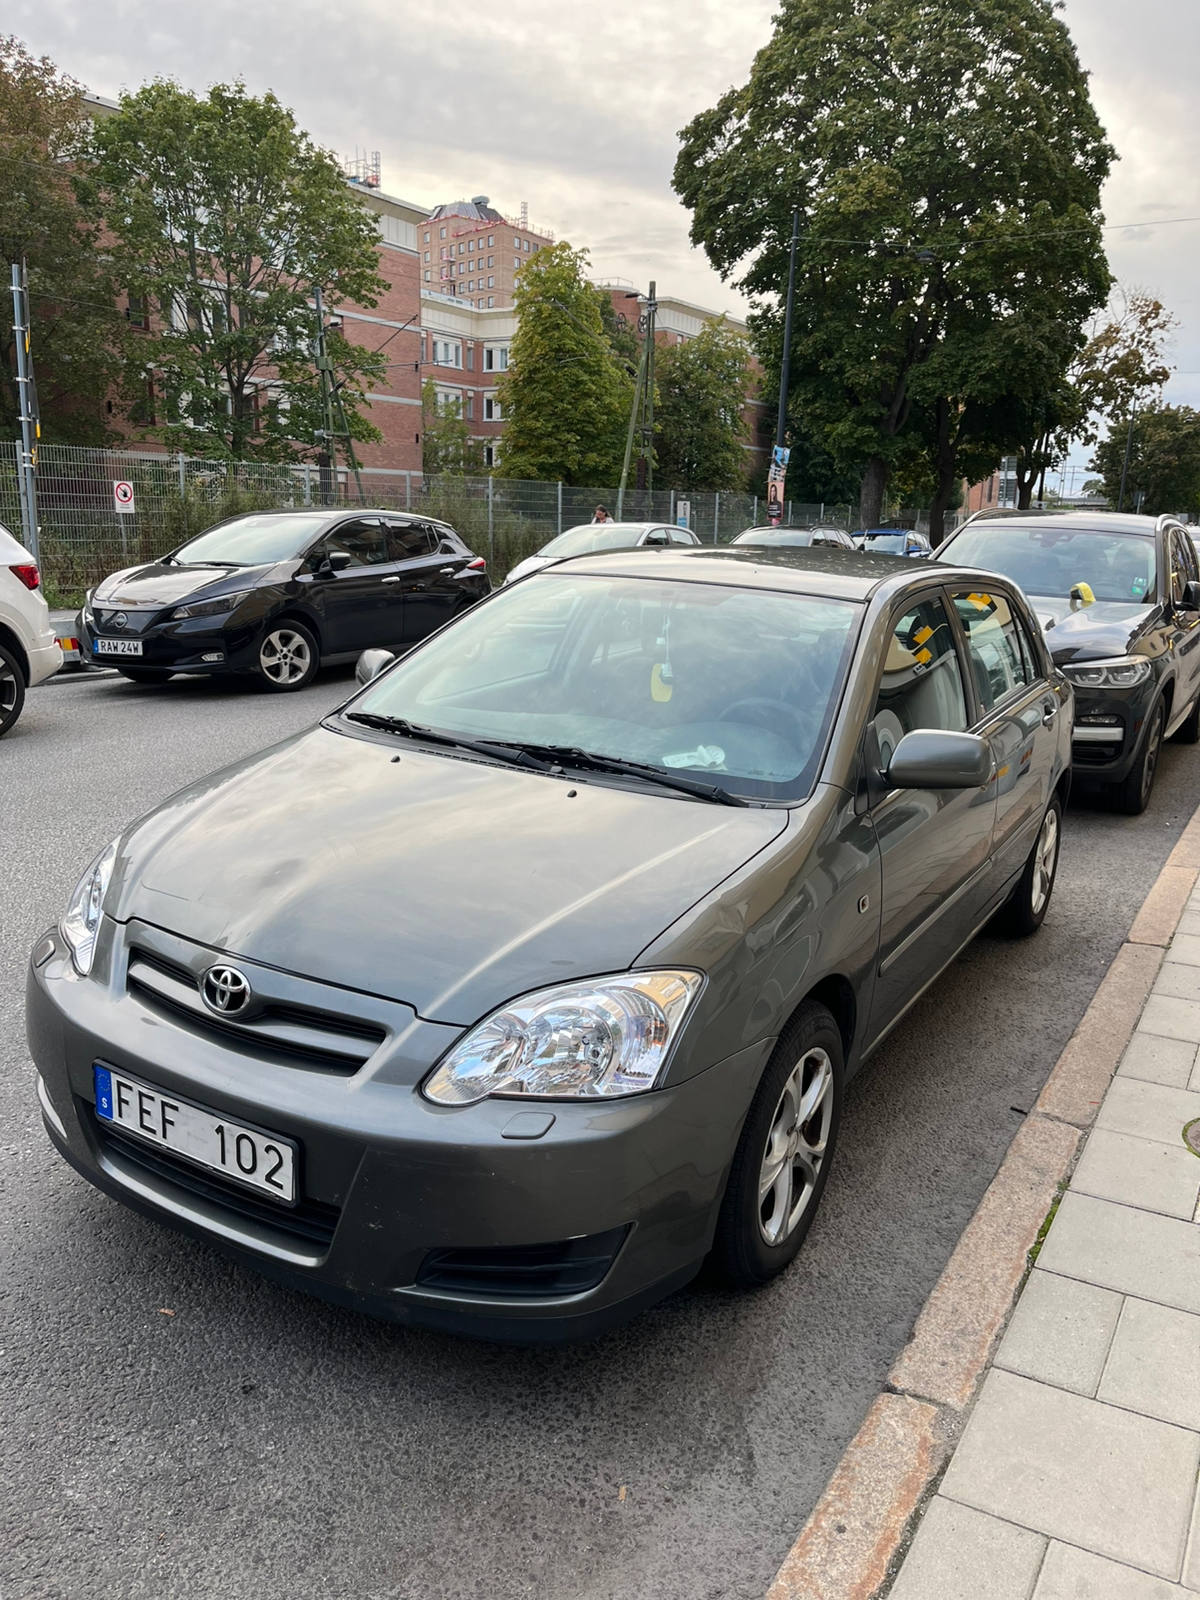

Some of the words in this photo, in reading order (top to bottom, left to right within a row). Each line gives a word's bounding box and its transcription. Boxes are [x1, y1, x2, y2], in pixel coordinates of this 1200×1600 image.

[100, 641, 119, 652] RAW
[120, 642, 139, 653] 24W
[101, 1097, 108, 1109] S
[116, 1079, 180, 1140] FEF
[214, 1124, 284, 1190] 102
